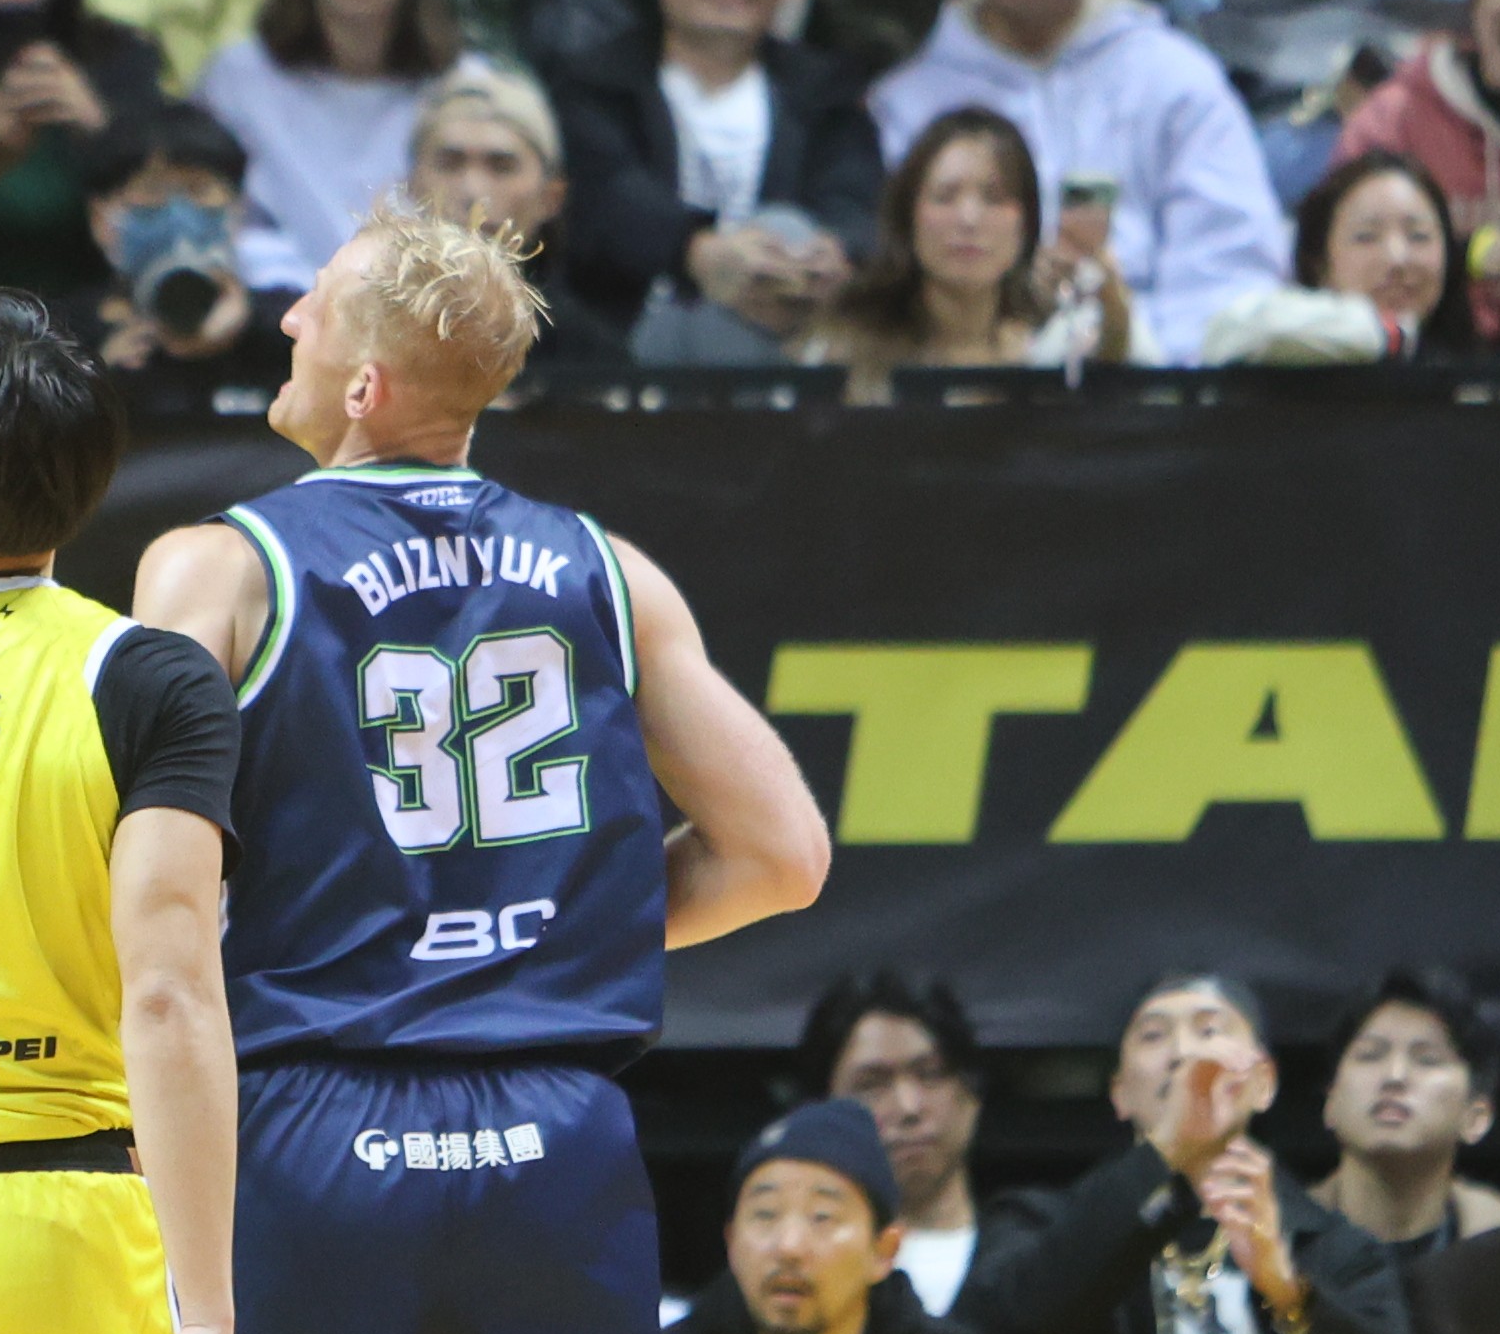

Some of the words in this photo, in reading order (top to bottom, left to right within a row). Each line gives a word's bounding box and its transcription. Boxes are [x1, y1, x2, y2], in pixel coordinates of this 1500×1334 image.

[342, 535, 571, 617] BLIZNYUK
[359, 626, 591, 855] 32
[409, 898, 556, 960] BC
[402, 1122, 545, 1171] 國揚集團
